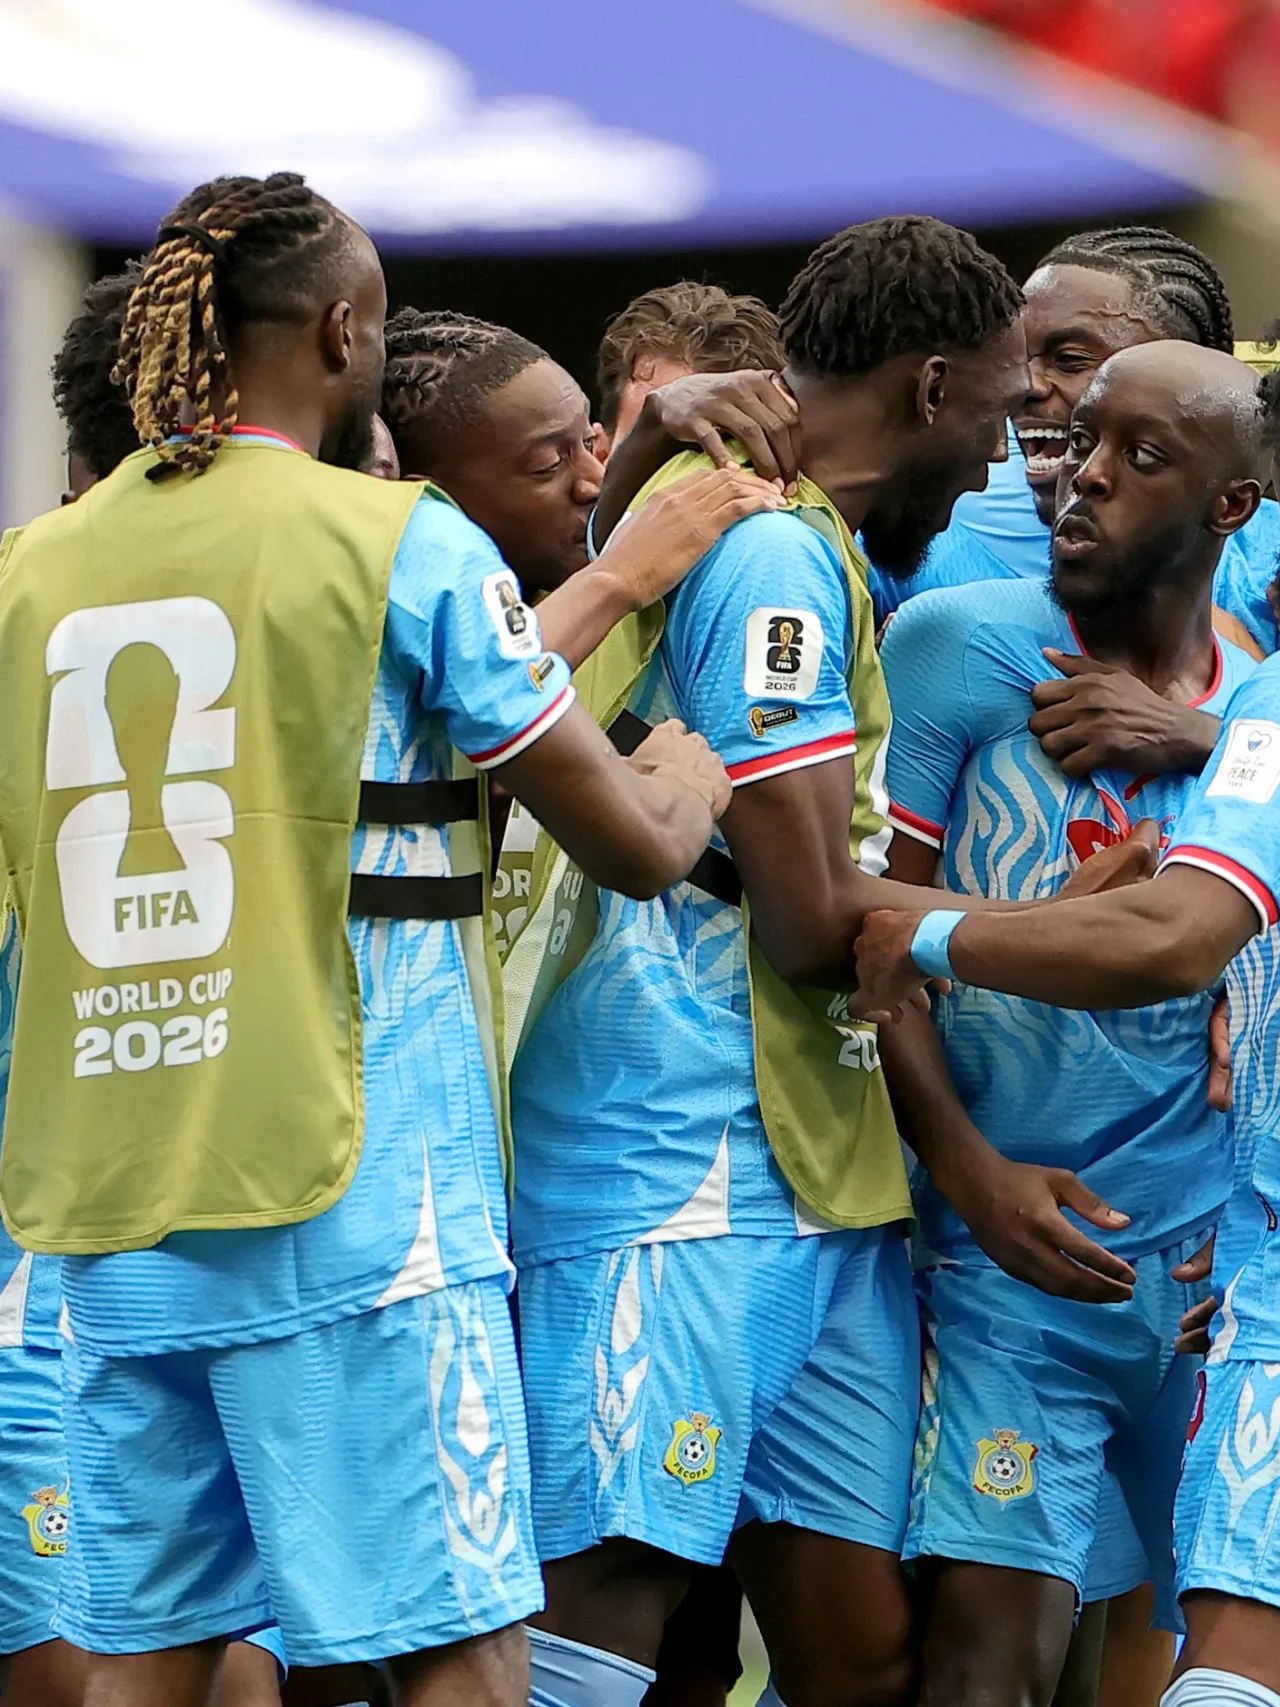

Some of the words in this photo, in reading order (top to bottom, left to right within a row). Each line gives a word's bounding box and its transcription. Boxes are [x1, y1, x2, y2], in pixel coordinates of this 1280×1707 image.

[776, 660, 793, 670] FIFA
[764, 681, 797, 692] 2026
[114, 889, 200, 933] FIFA
[72, 978, 184, 1020] WORLD
[188, 967, 233, 1005] CUP
[73, 1007, 229, 1079] 2026
[673, 1461, 708, 1479] FECOFA
[982, 1482, 1024, 1496] FECOFA
[43, 1541, 68, 1553] FEC
